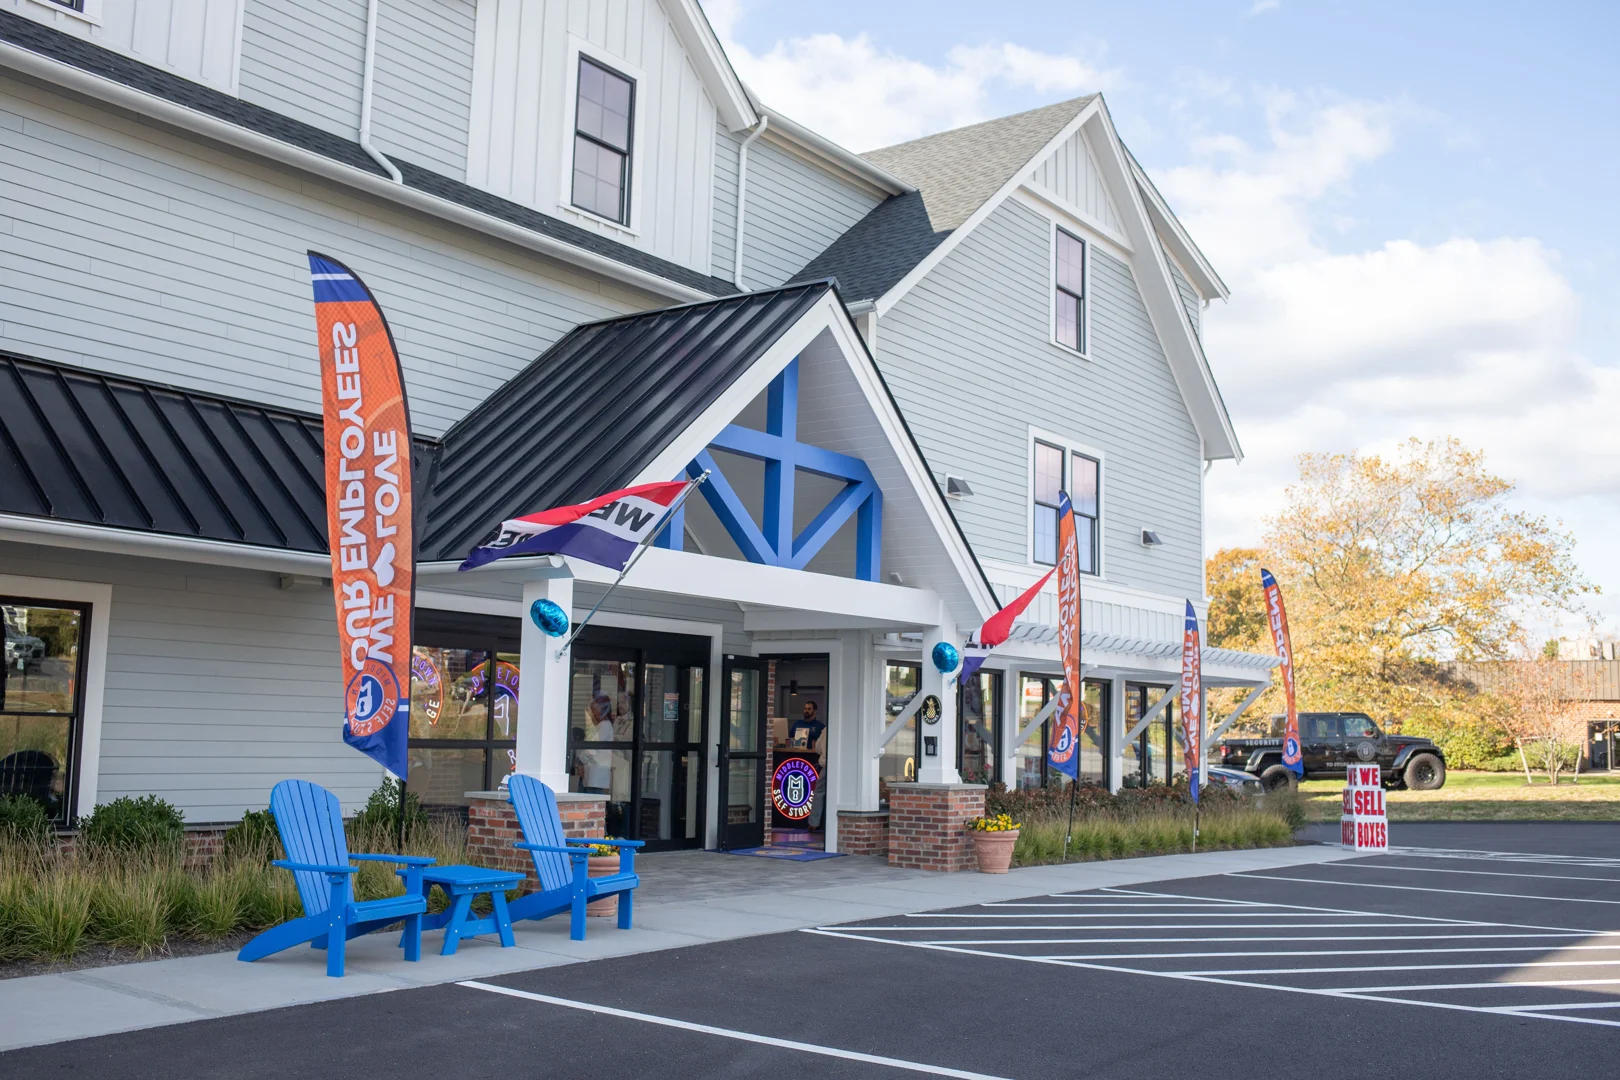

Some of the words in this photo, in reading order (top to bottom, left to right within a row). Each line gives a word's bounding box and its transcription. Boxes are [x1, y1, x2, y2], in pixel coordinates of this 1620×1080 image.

[775, 760, 818, 782] MIDDLETOWN
[1359, 768, 1379, 786] WE
[773, 789, 787, 811] SELF
[1354, 790, 1385, 816] SELL
[1357, 822, 1386, 848] BOXES
